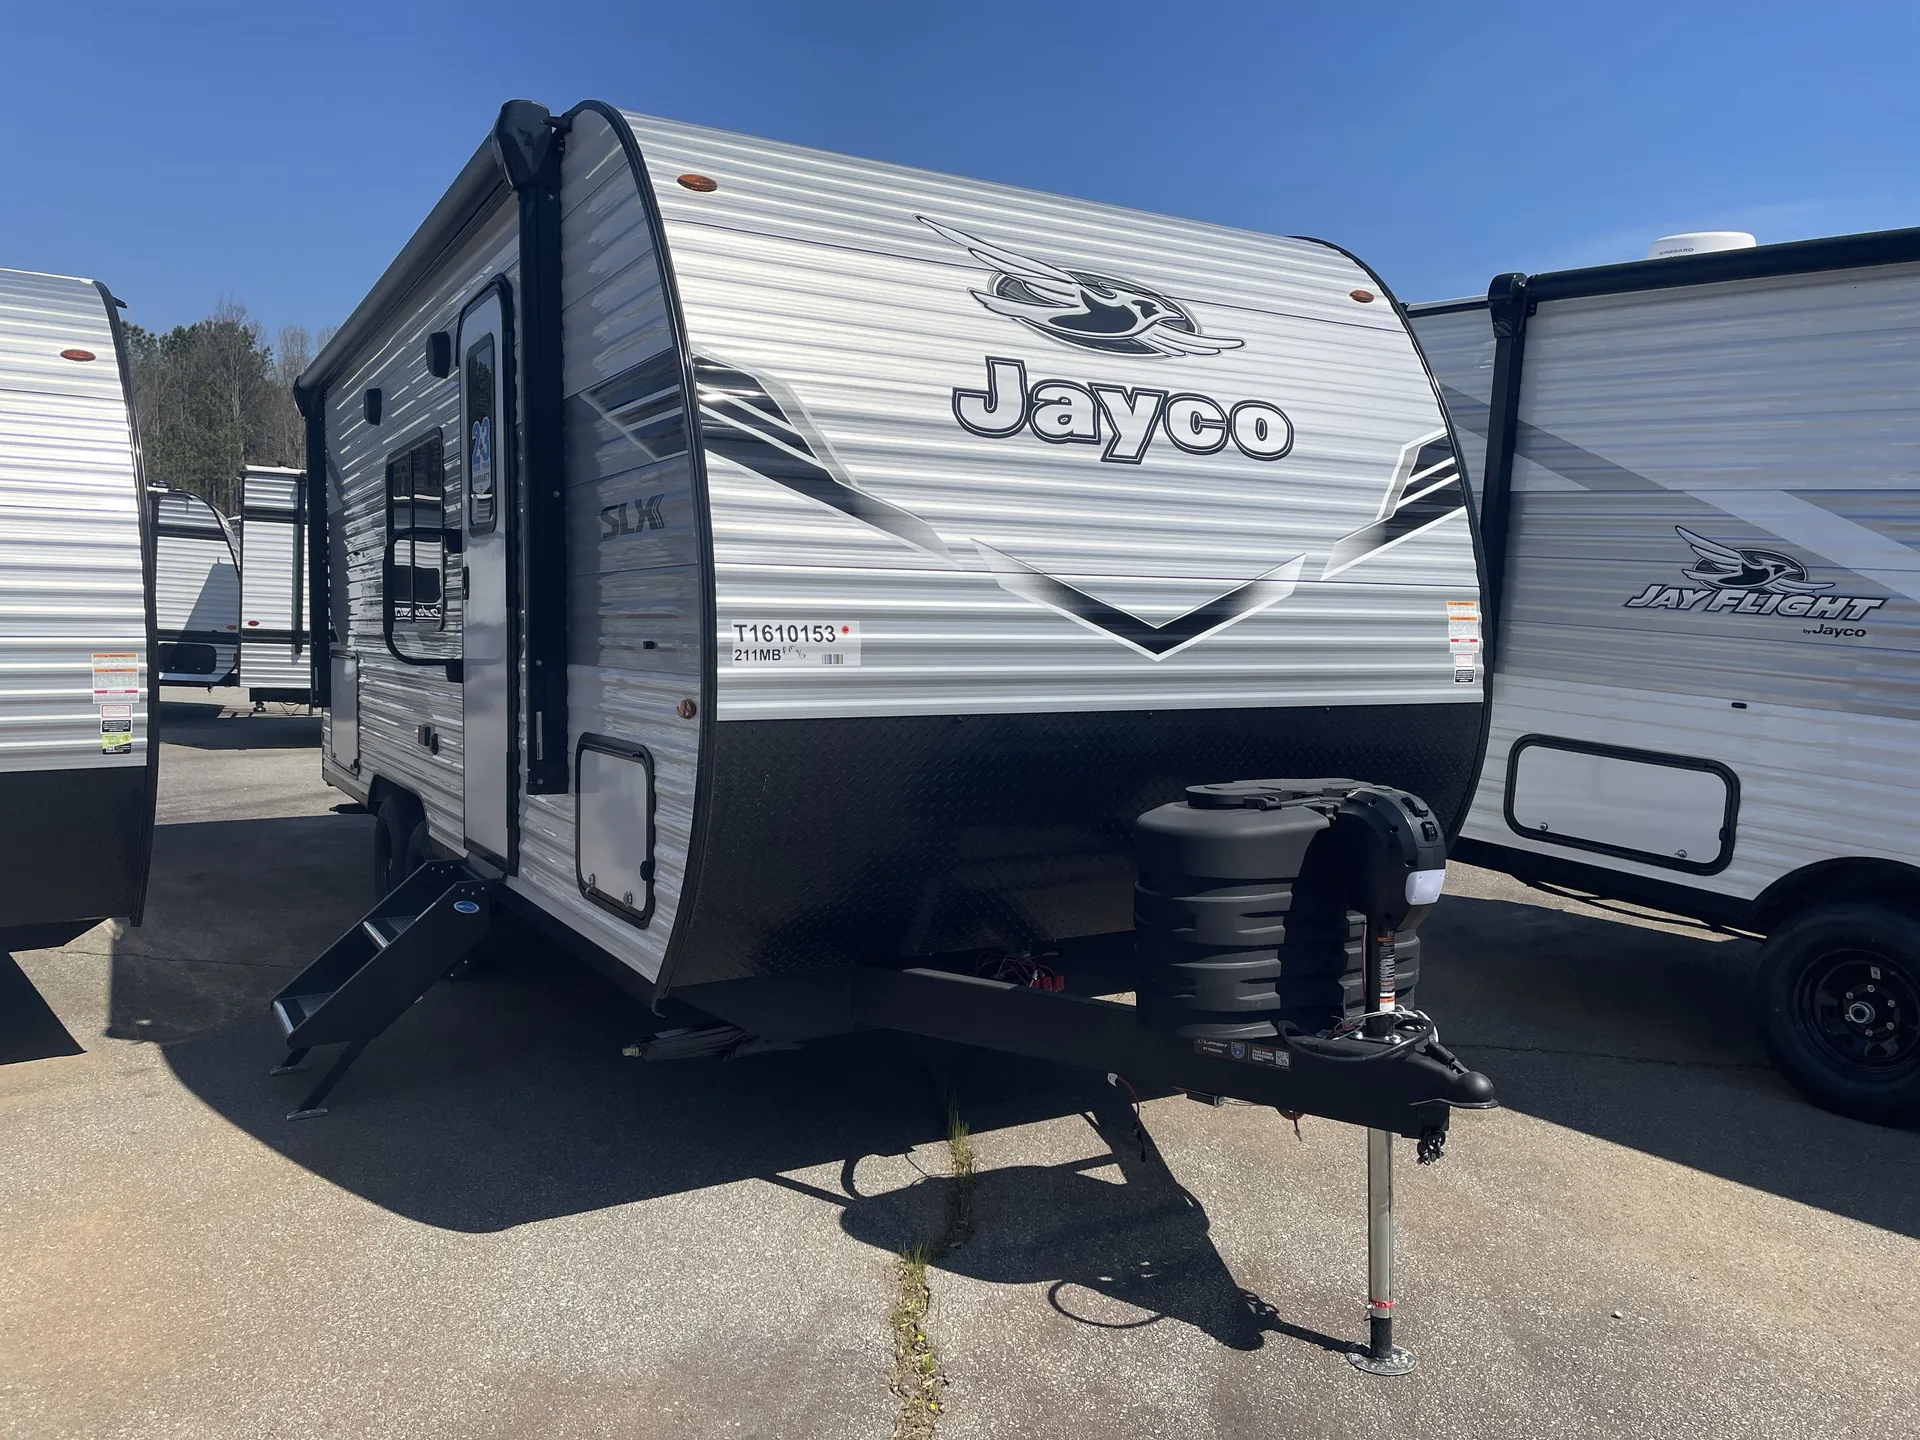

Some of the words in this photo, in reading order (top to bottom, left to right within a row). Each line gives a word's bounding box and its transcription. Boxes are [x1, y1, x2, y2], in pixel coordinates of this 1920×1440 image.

[952, 356, 1295, 465] Jayco
[600, 494, 666, 540] SLX
[1624, 584, 1714, 611] JAY
[1704, 588, 1890, 622] FLIGHT
[733, 624, 836, 643] T1610153
[1812, 624, 1867, 639] Jayco
[734, 648, 781, 661] 211MB
